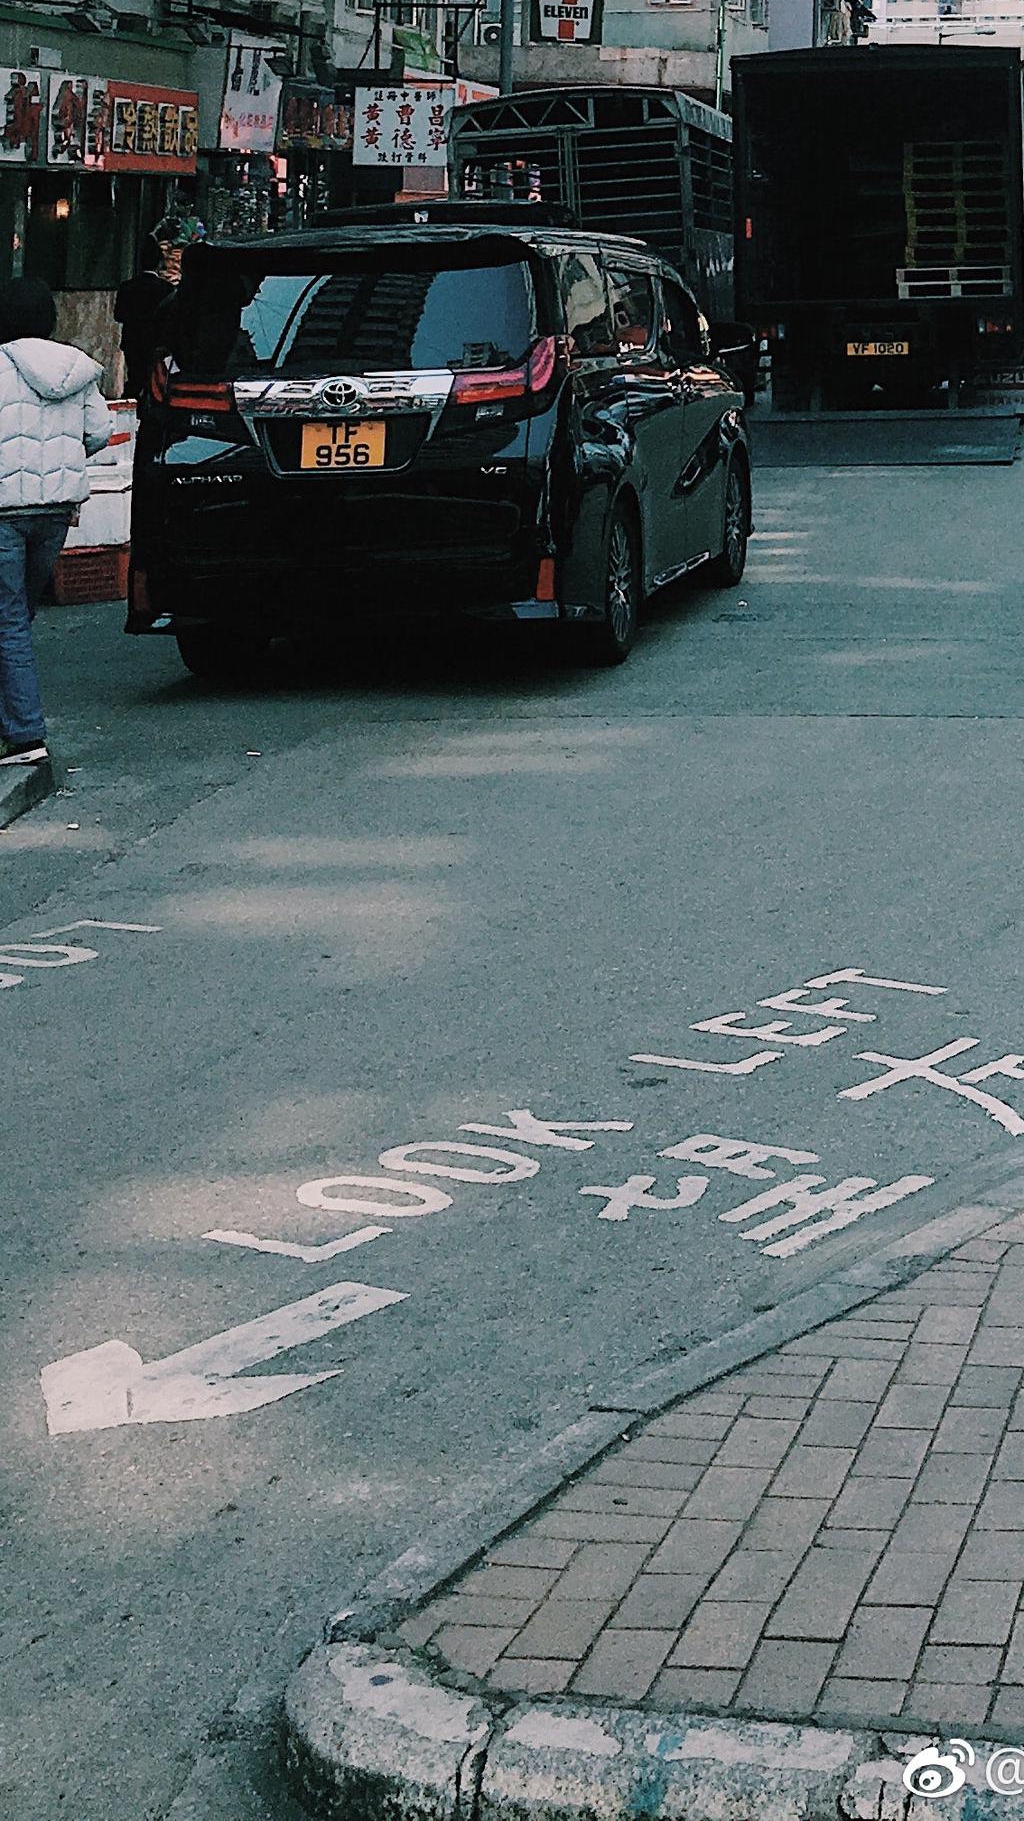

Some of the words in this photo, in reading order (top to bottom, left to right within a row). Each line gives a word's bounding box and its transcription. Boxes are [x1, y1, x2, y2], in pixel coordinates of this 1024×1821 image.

[327, 422, 361, 444] TF
[316, 444, 370, 466] 956
[200, 1109, 634, 1263] LOOK
[628, 968, 949, 1075] LEFT
